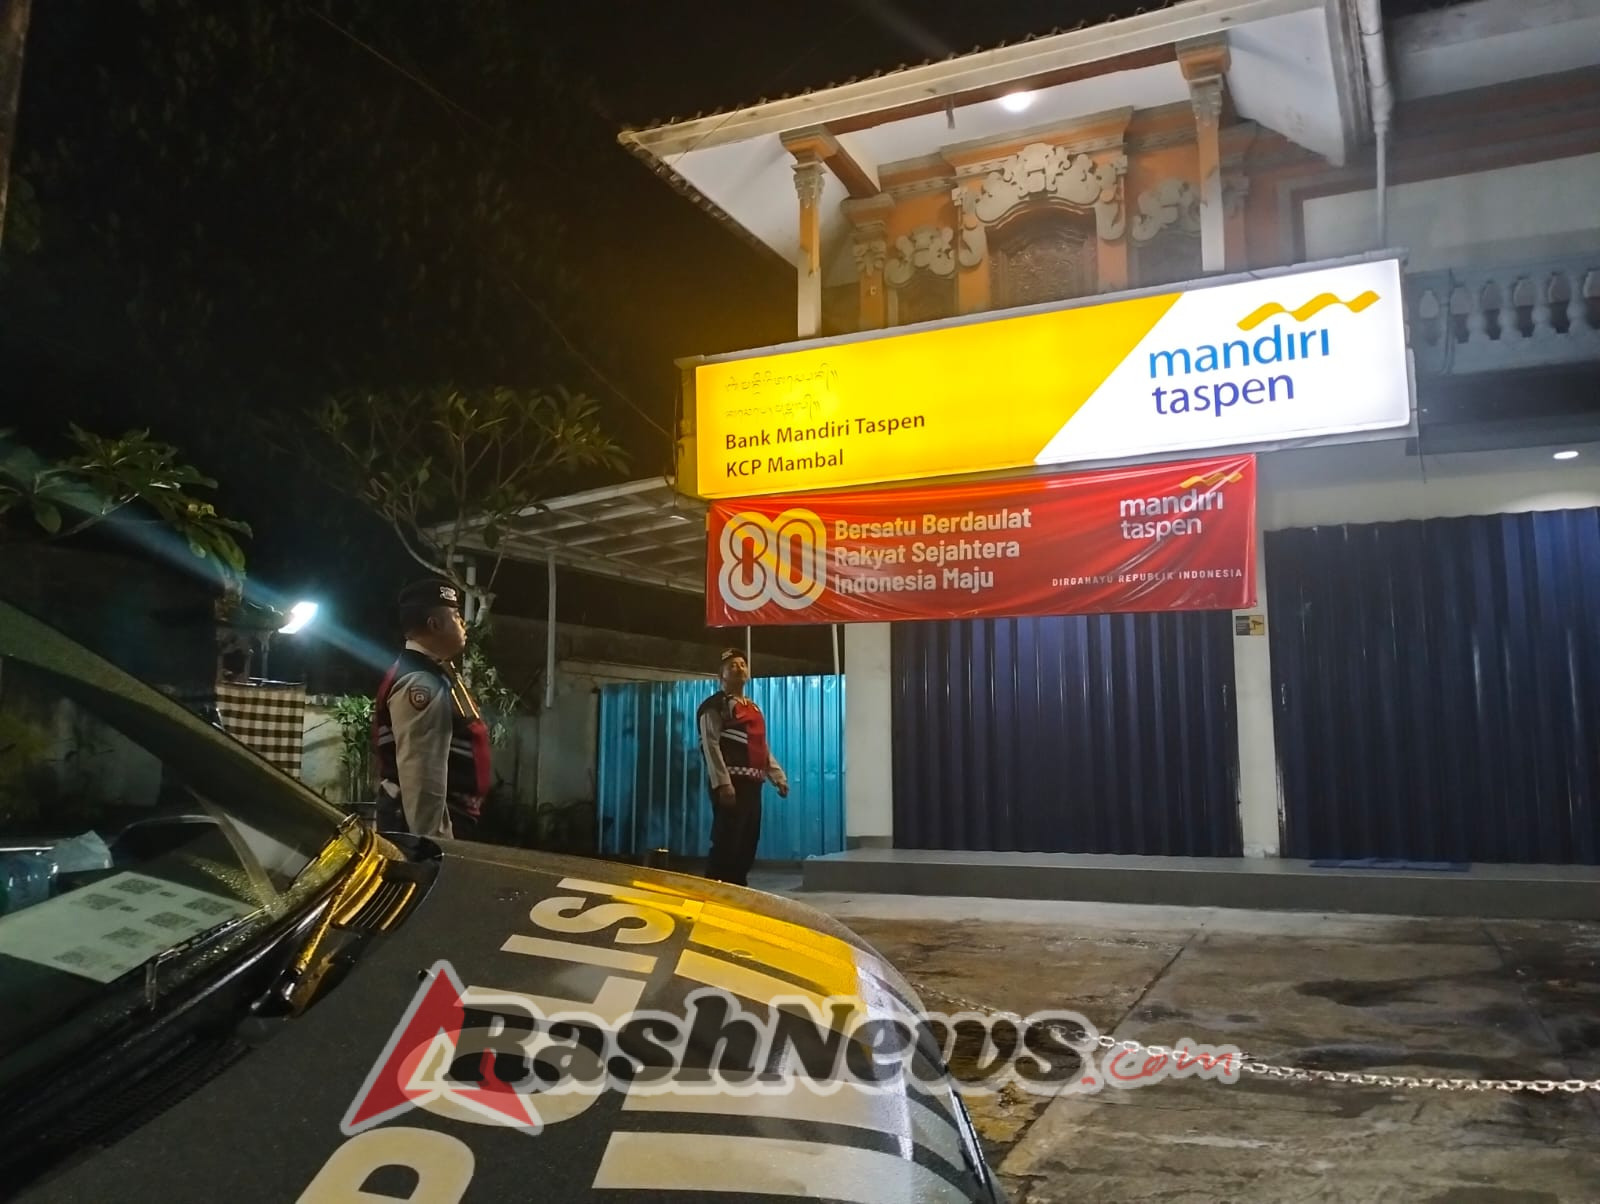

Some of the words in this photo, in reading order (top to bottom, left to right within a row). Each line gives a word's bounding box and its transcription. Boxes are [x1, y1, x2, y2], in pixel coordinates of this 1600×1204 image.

[1149, 324, 1330, 379] mandiri
[1151, 374, 1295, 417] taspen
[725, 429, 771, 450] Bank
[776, 419, 850, 445] Mandiri
[854, 414, 925, 435] Taspen
[726, 459, 762, 478] KCP
[767, 448, 844, 473] Mambal
[1119, 489, 1224, 517] mandiri
[834, 516, 917, 541] Bersatu
[922, 508, 1032, 535] Berdaulat
[1120, 517, 1203, 542] taspen
[718, 508, 827, 612] 80
[834, 543, 906, 570] Rakyat
[911, 540, 1020, 567] Sejahtera
[834, 569, 937, 594] Indonesia
[942, 567, 994, 594] Maju
[1052, 576, 1114, 587] DIRGAHAYU
[1118, 571, 1175, 584] REPUBLIK
[1178, 569, 1243, 580] INDONESIA
